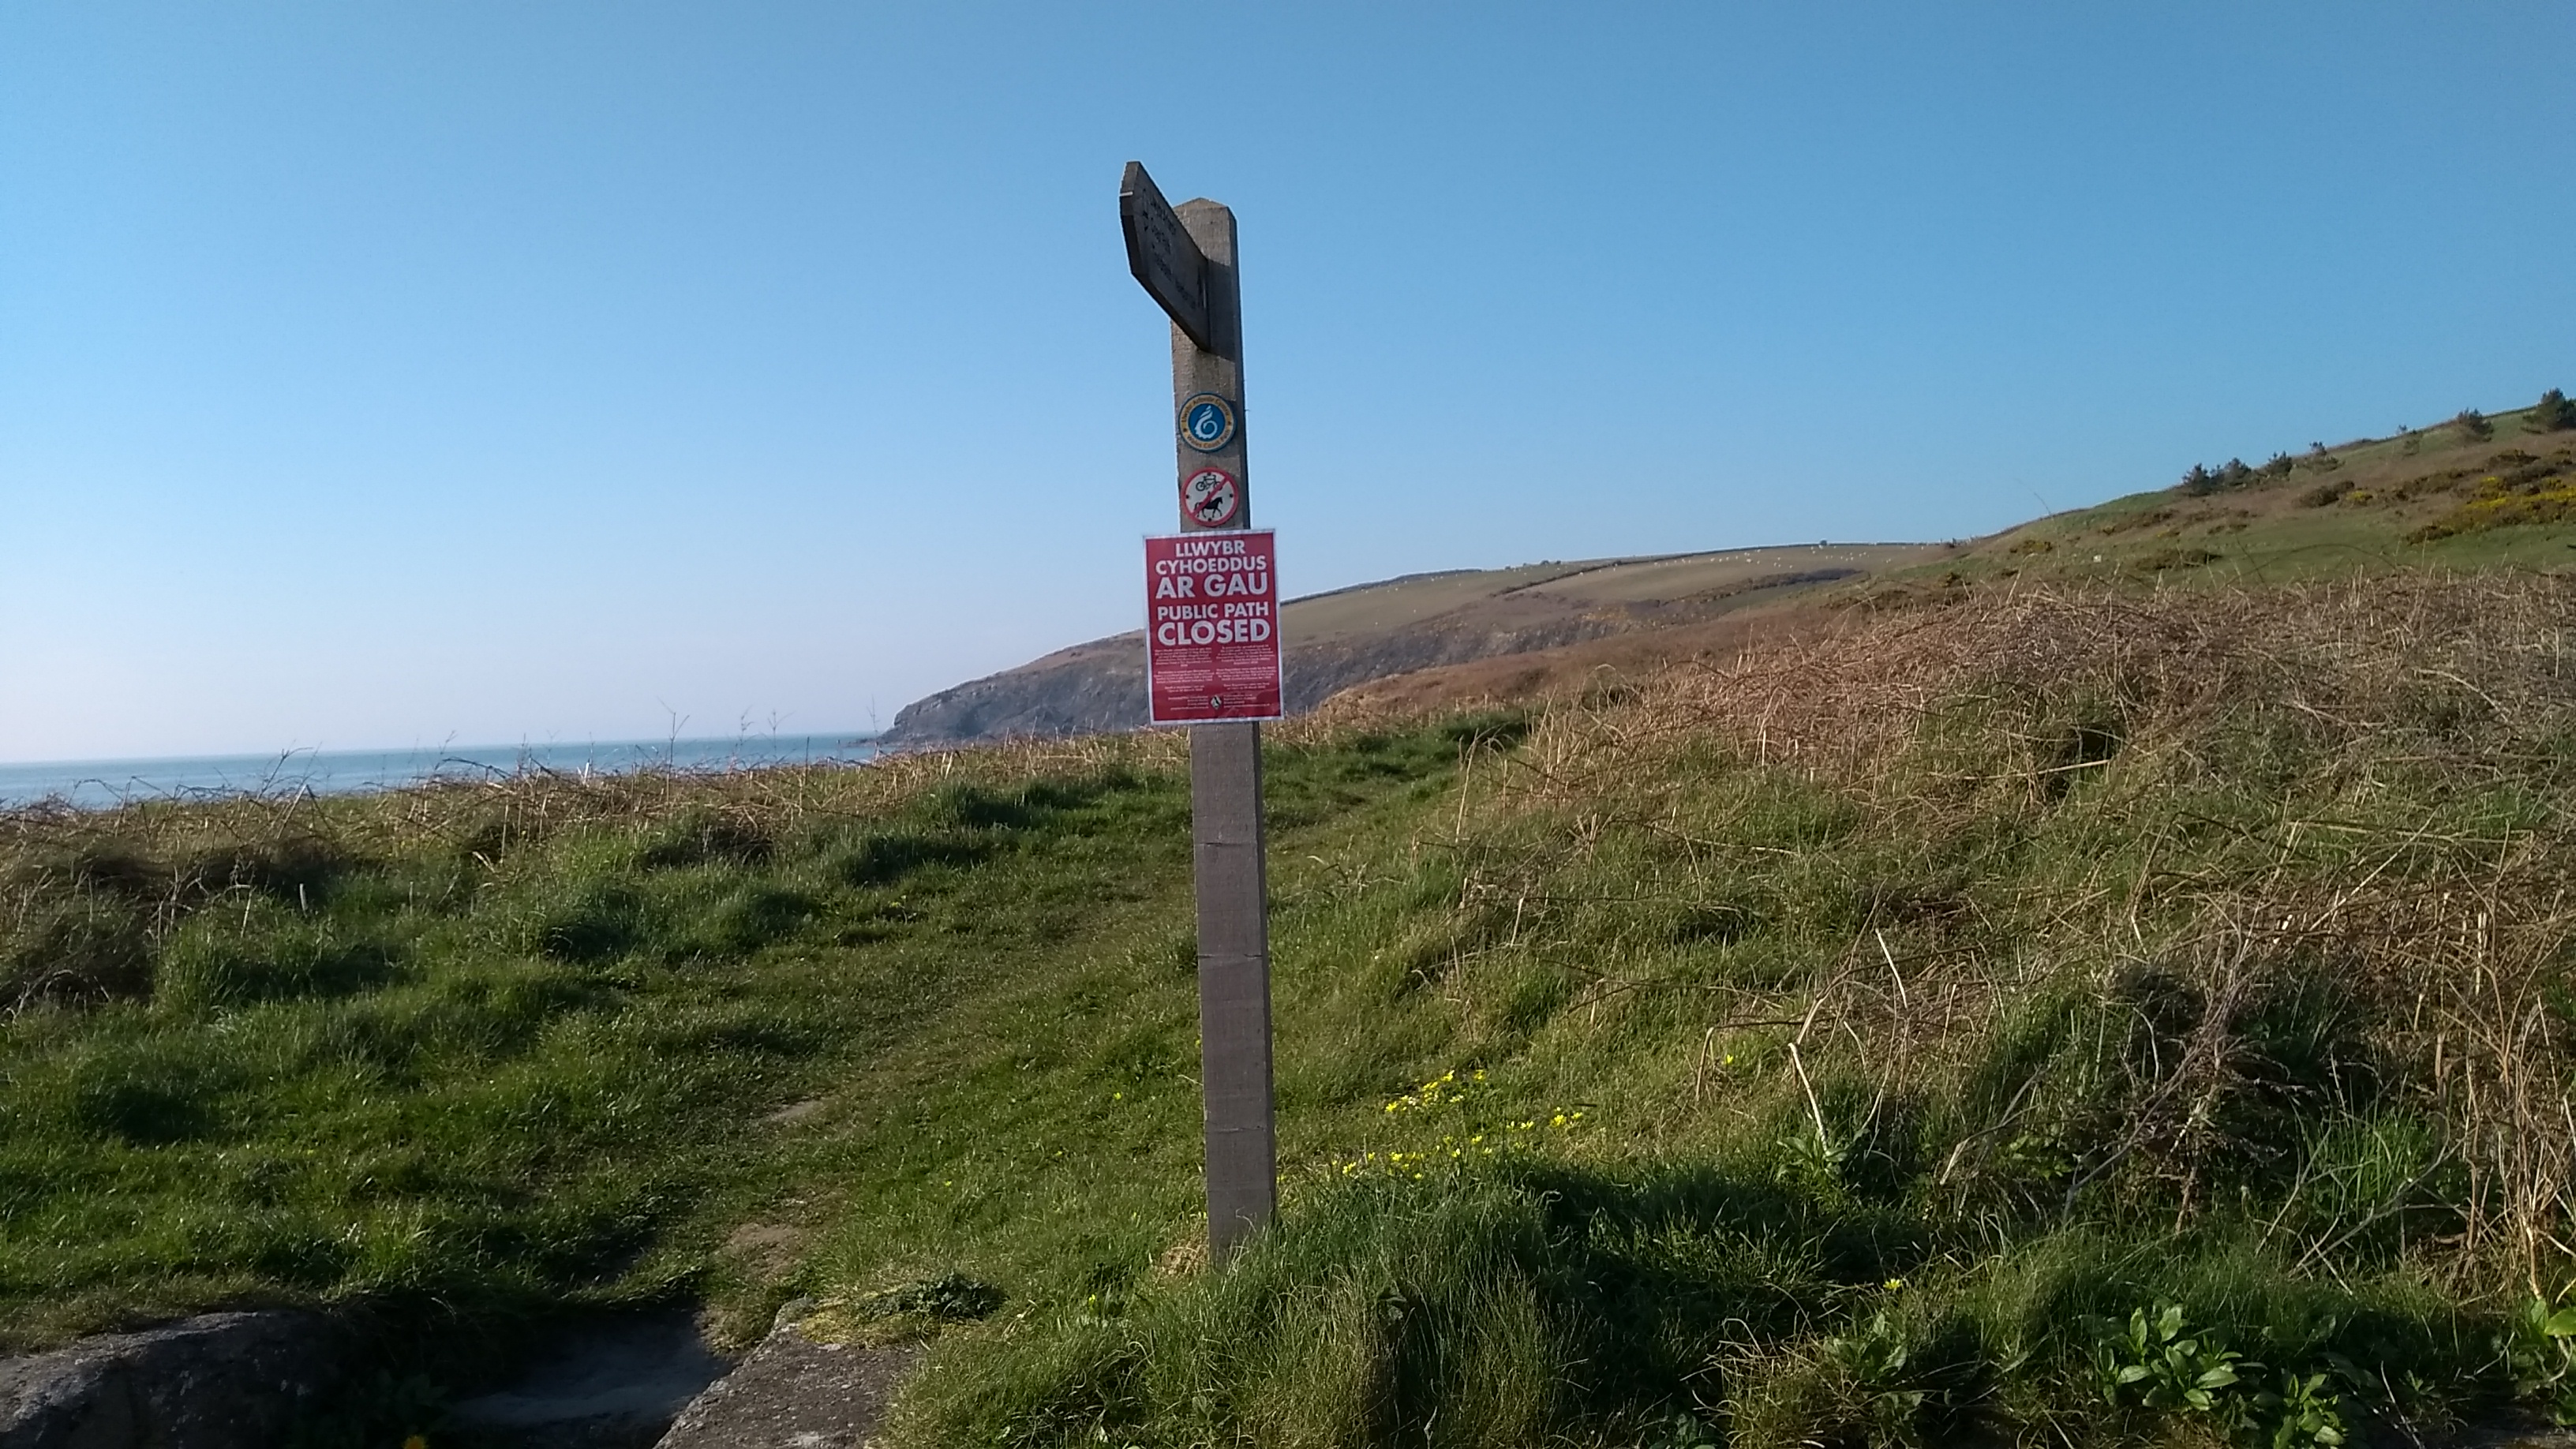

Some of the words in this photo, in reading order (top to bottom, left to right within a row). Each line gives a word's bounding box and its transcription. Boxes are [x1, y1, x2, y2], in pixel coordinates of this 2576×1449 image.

[1176, 541, 1245, 557] LLWYBR
[1155, 556, 1266, 575] CYHOEDDUS
[1155, 576, 1196, 599] AR
[1204, 572, 1267, 597] GAU
[1157, 604, 1219, 621] PUBLIC
[1224, 601, 1269, 618] PATH
[1158, 619, 1271, 646] CLOSED
